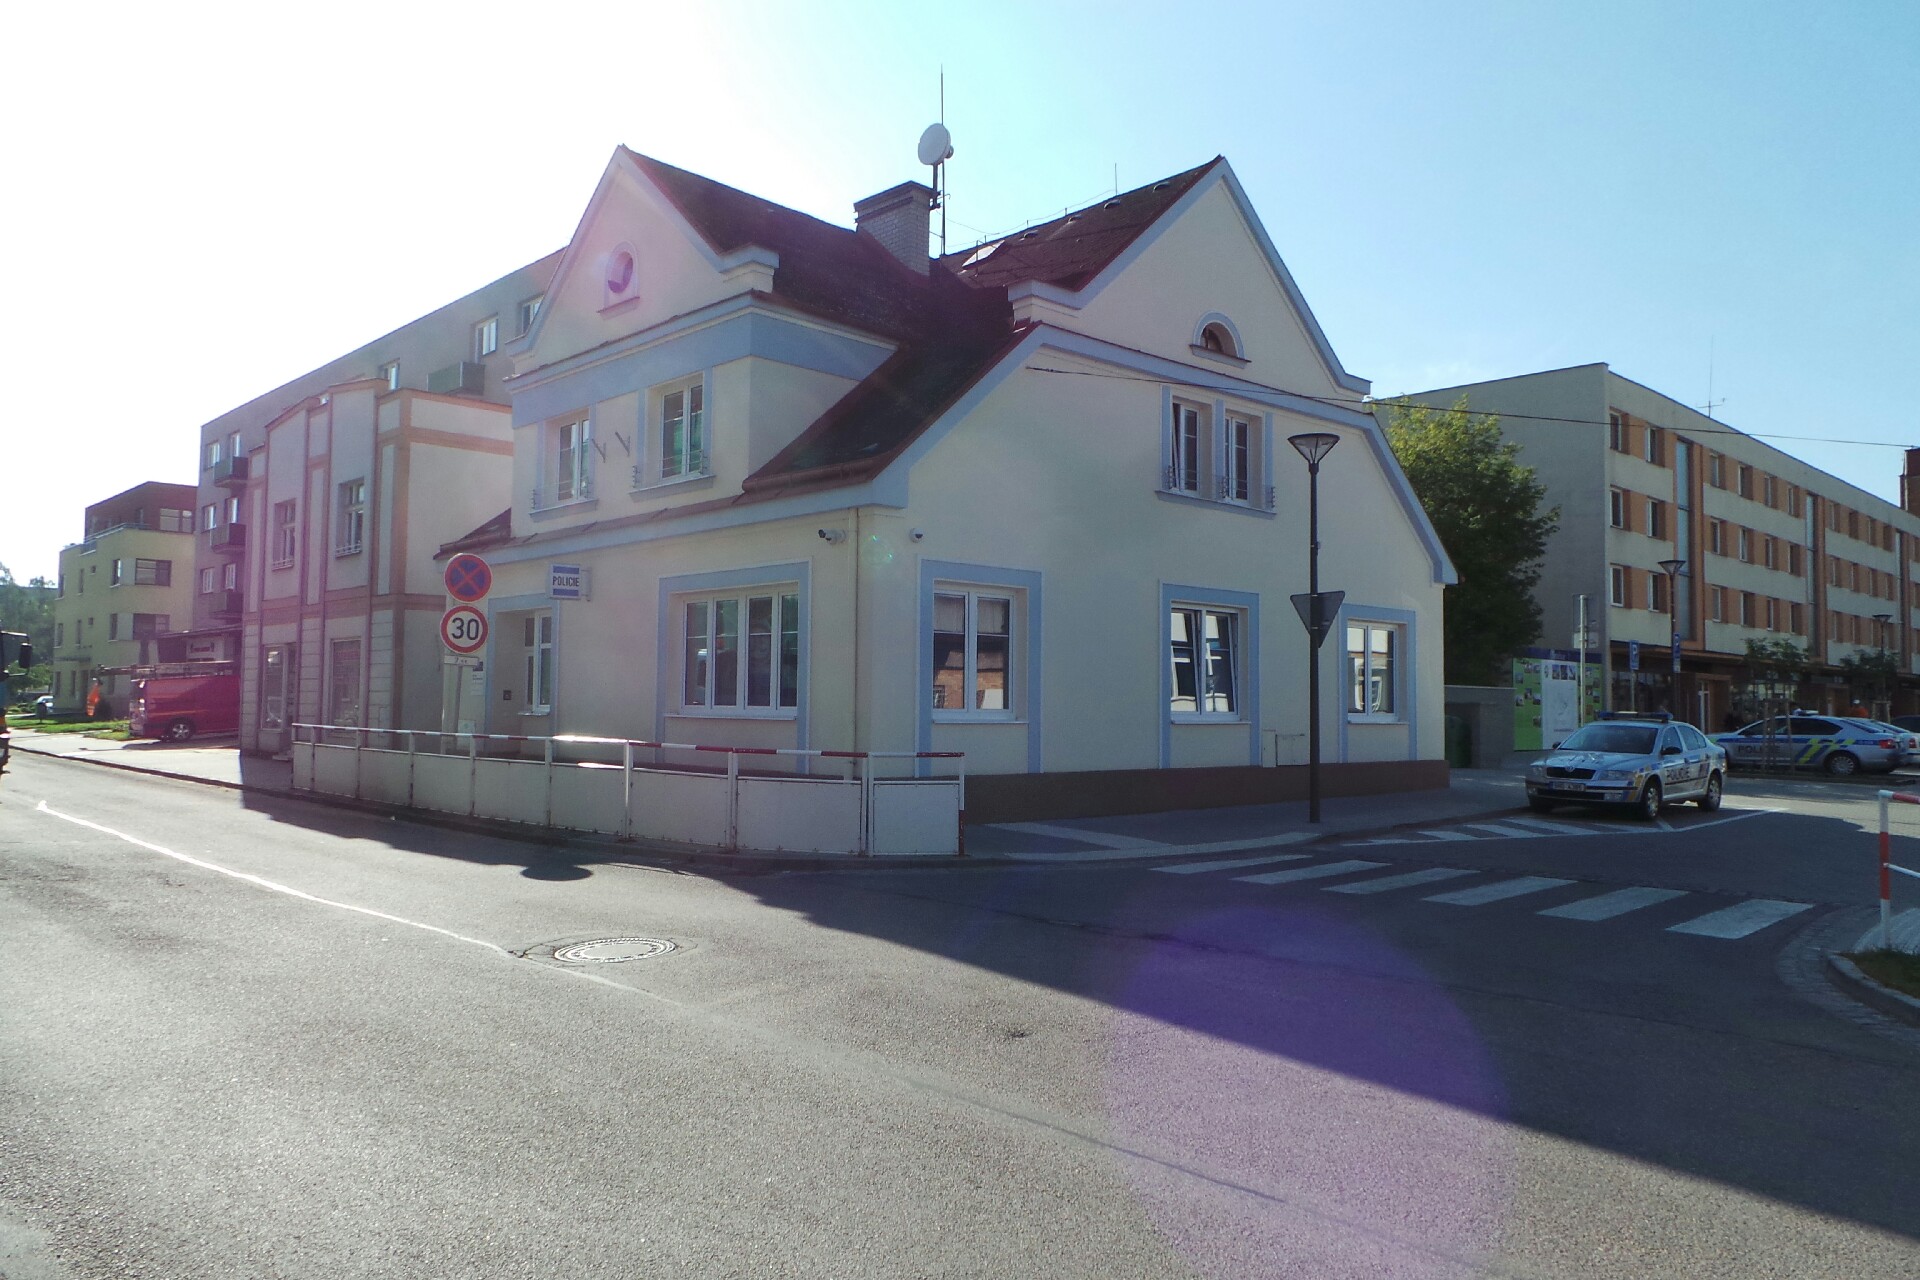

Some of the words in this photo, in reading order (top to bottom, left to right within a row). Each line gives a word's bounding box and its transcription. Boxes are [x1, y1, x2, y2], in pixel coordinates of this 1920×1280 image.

[553, 576, 580, 587] POLICIE
[451, 617, 480, 641] 30
[1666, 767, 1690, 780] POLICIE
